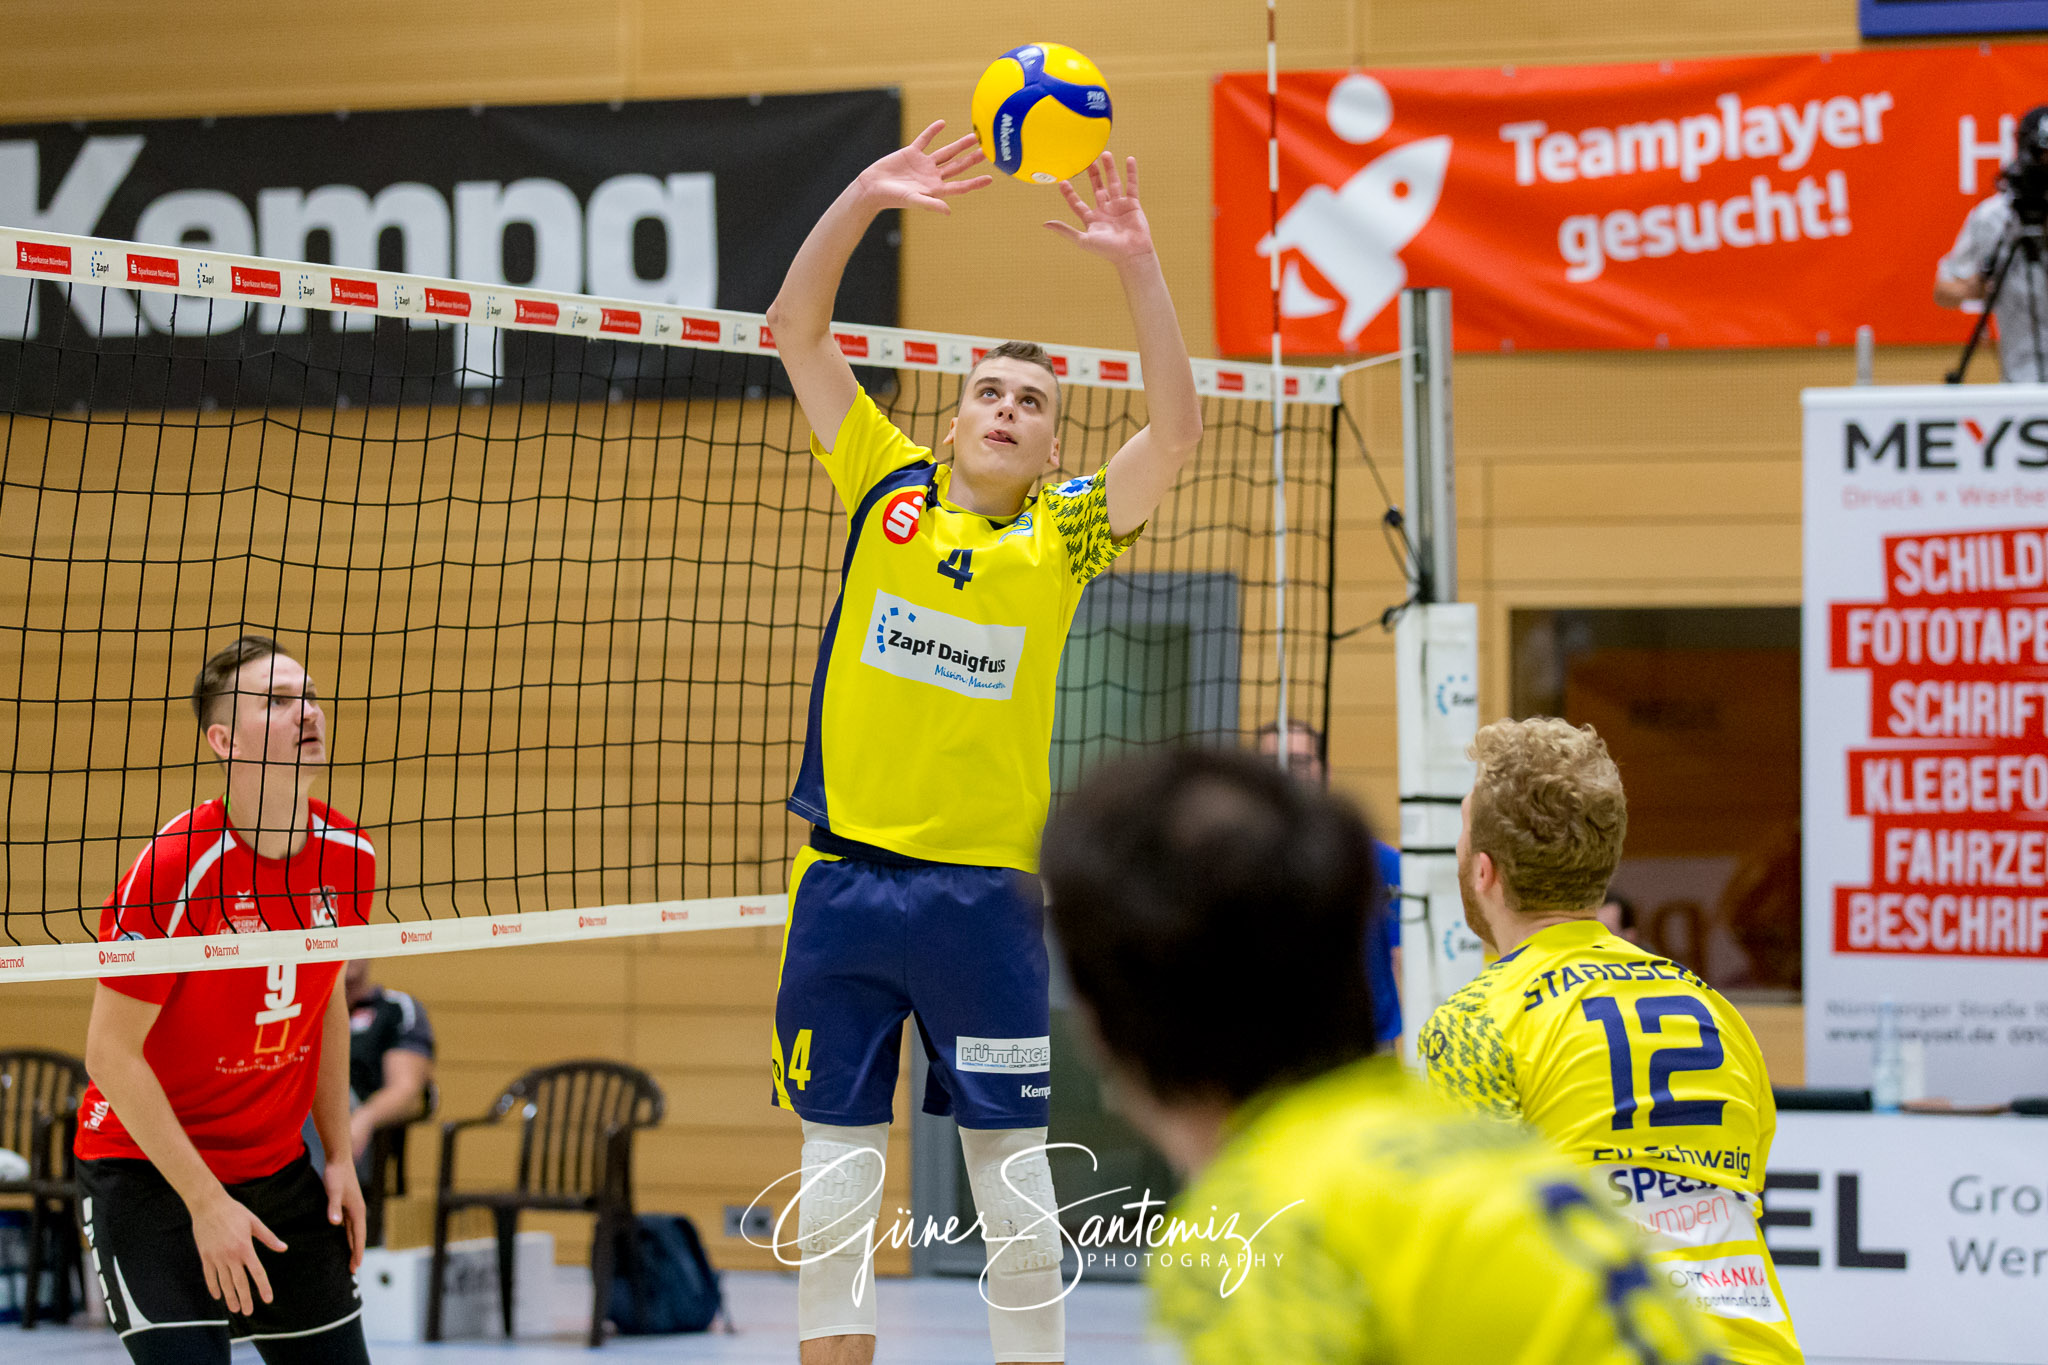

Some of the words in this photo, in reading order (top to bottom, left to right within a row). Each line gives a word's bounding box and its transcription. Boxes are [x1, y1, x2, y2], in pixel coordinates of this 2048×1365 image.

[1500, 91, 1893, 185] Teamplayer
[1558, 171, 1851, 283] gesucht!
[0, 135, 719, 390] Kempa
[28, 255, 49, 266] Sparkasse
[49, 257, 68, 269] Nürnberg
[96, 262, 110, 273] Zapf
[202, 275, 215, 285] Zapf
[303, 287, 315, 296] Zapf
[1845, 419, 2048, 470] MEYS
[937, 548, 974, 590] 4
[1894, 532, 2048, 596] SCHILD
[888, 629, 936, 656] Zapf
[938, 643, 1006, 673] Daigfuss
[1846, 607, 2048, 665] FOTOTAPE
[1862, 754, 2048, 815] KLEBEFO
[1885, 828, 2048, 888] FAHRZE
[311, 937, 339, 950] Marmot
[407, 930, 433, 942] Marmot
[1847, 892, 2048, 953] BESCHRIF
[105, 950, 136, 964] Marmot
[211, 944, 240, 957] Marmot
[788, 1029, 813, 1091] 4
[1581, 995, 1724, 1131] 12
[1949, 1174, 2048, 1215] Gro
[1948, 1237, 2048, 1277] Wer
